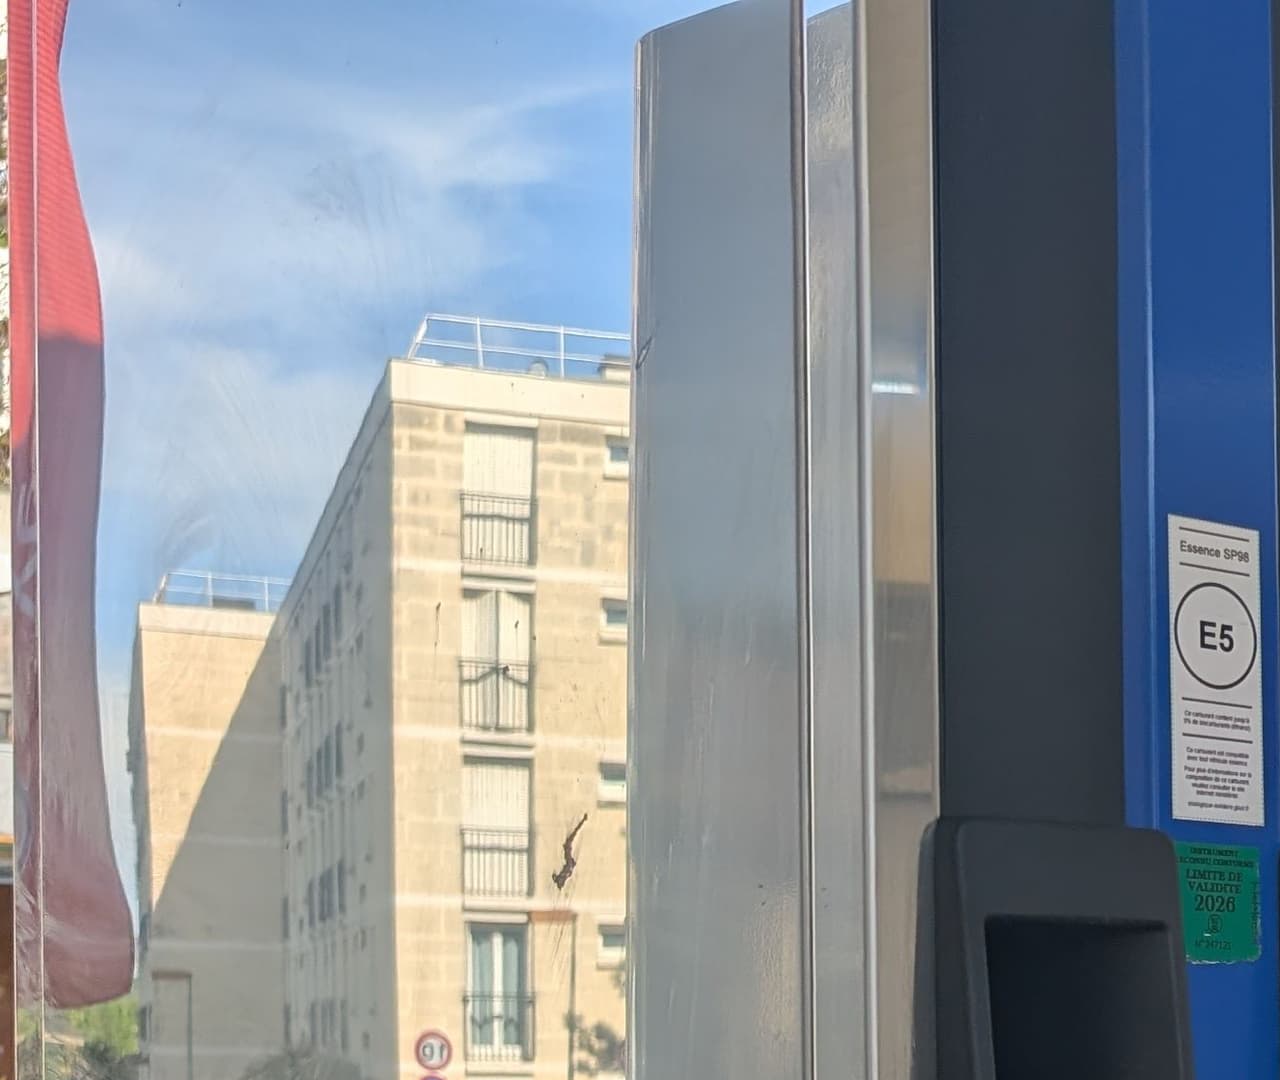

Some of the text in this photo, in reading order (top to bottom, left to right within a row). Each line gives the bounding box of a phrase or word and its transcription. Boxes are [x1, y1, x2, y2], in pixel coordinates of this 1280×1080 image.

[1179, 540, 1249, 563] Essence SP98
[1199, 619, 1234, 653] E5
[1186, 869, 1243, 882] LIMITE DE
[1194, 894, 1236, 913] 2026
